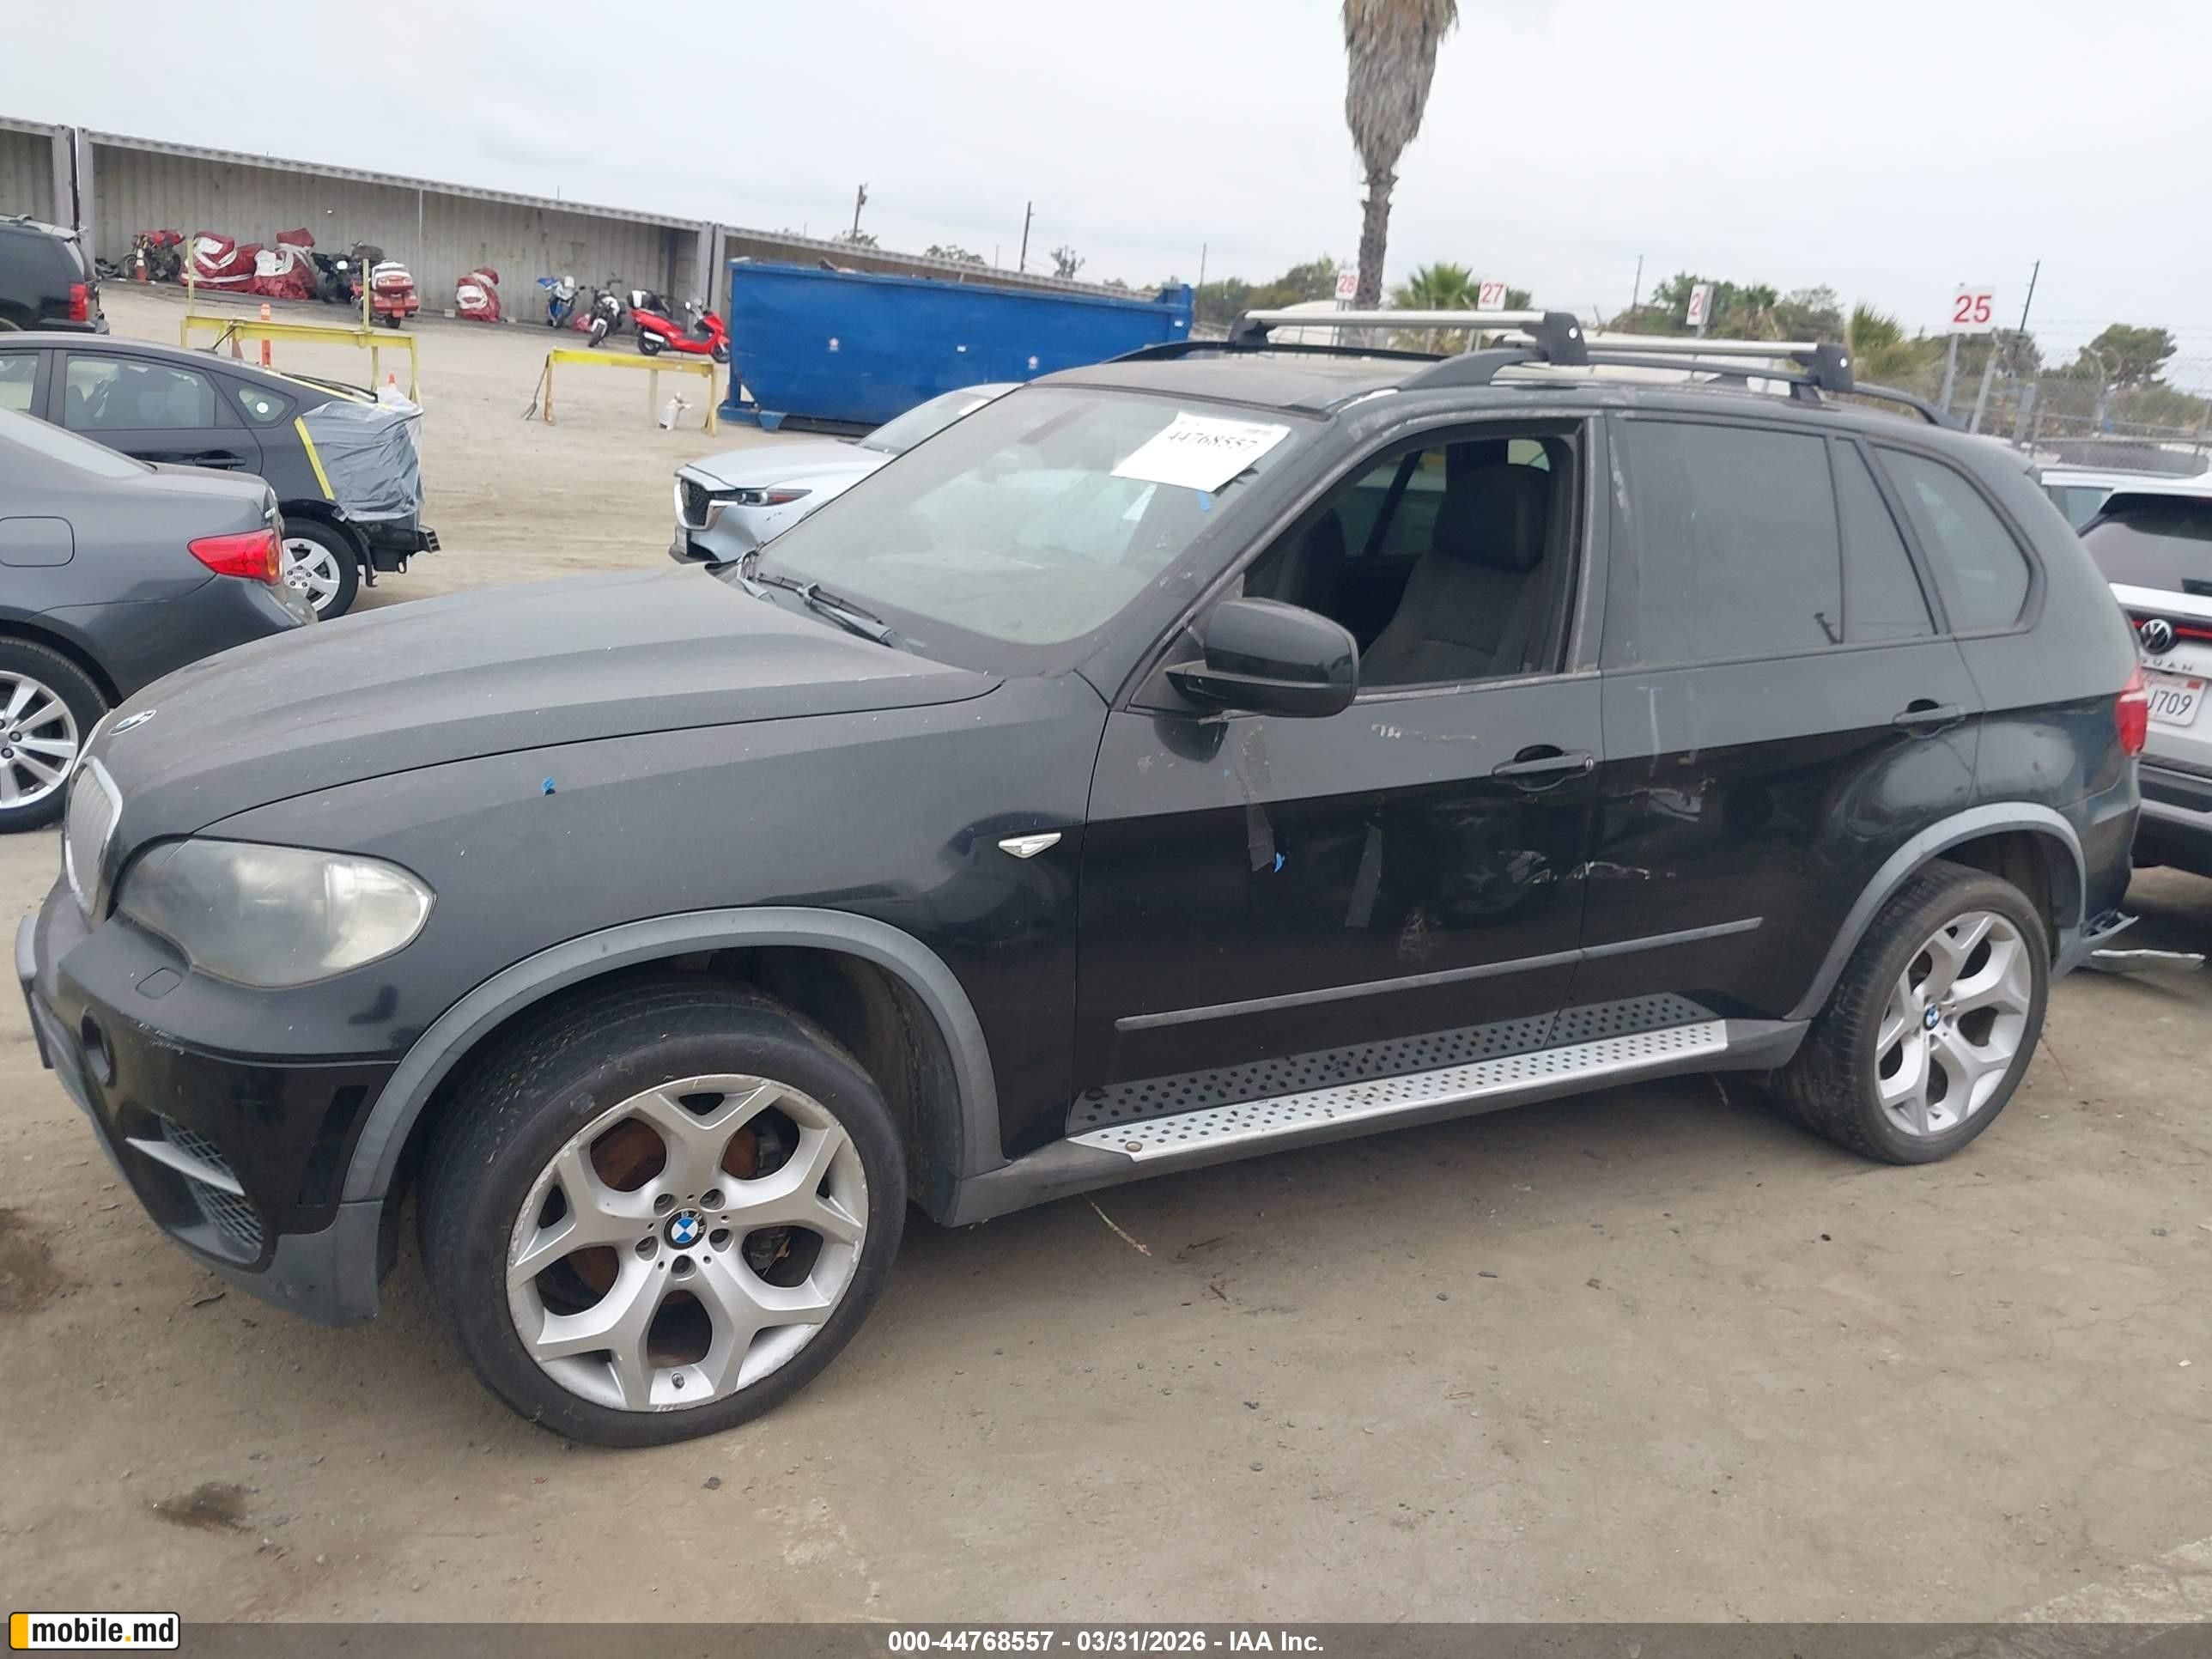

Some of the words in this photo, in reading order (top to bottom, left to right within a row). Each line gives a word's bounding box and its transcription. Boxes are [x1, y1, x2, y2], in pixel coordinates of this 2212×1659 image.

[1339, 274, 1356, 293] 28
[1480, 283, 1504, 304] 27
[1954, 294, 1993, 323] 25
[2142, 659, 2192, 672] UAN
[680, 1211, 706, 1234] BMW
